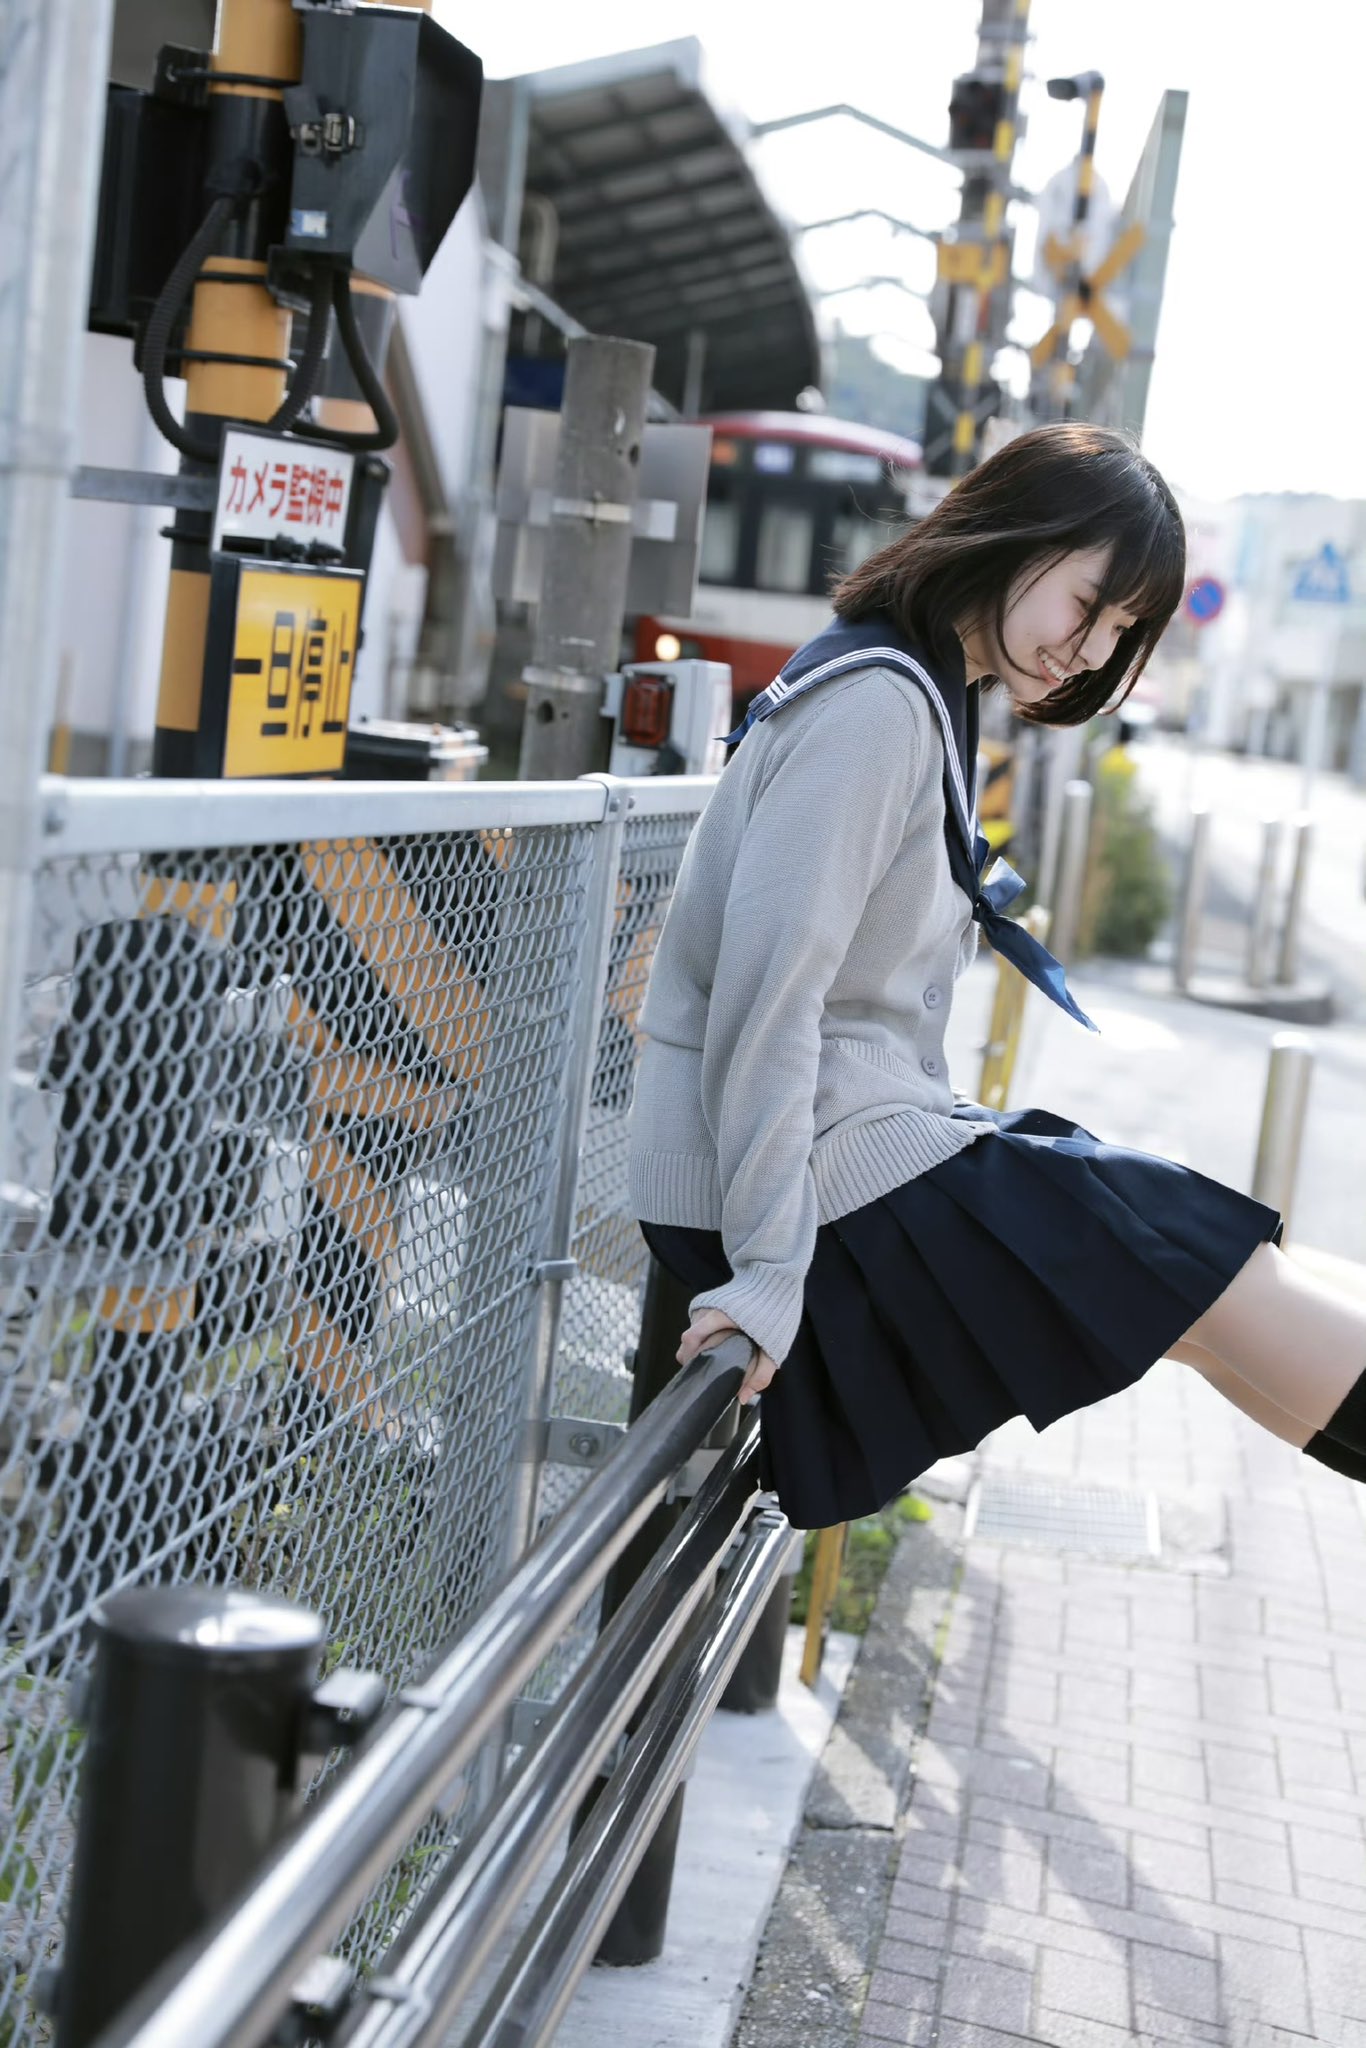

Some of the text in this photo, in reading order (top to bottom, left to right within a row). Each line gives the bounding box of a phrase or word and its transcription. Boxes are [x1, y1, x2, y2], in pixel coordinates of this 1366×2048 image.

[226, 455, 344, 527] カメラ監視中
[232, 609, 349, 739] 一旦停止
